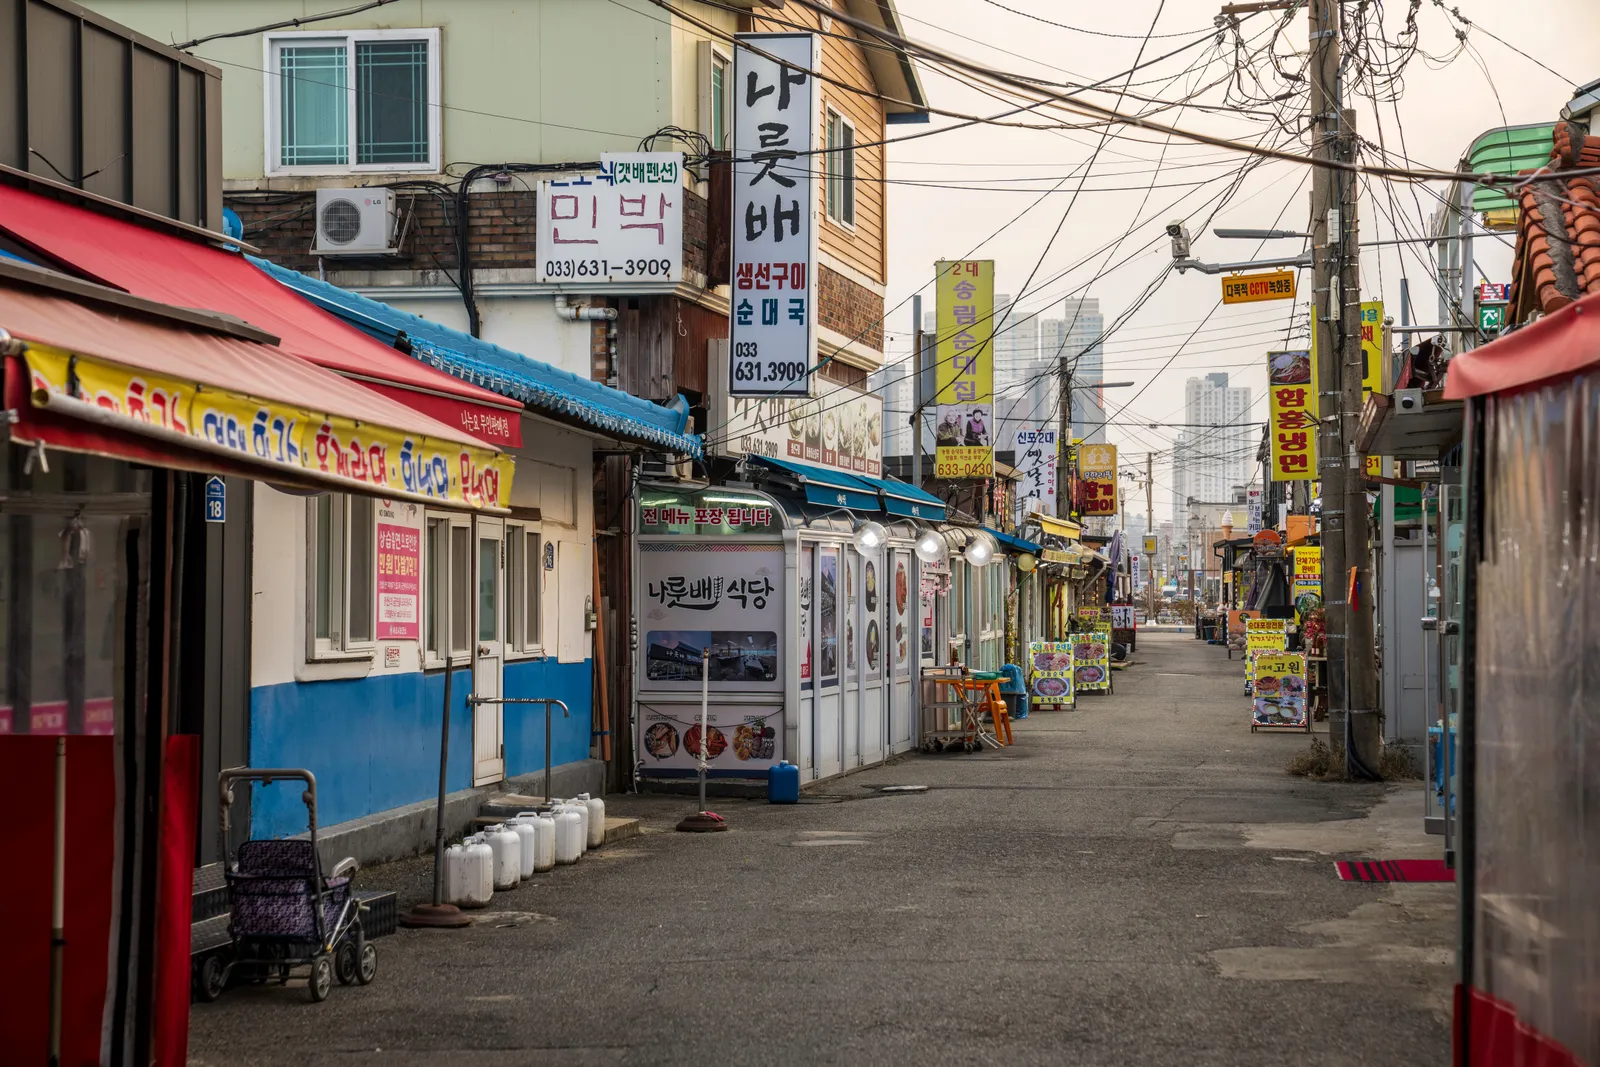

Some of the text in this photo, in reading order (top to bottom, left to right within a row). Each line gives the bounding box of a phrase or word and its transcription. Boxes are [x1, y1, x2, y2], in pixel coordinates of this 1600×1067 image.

[744, 60, 807, 244] 나룻배
[550, 192, 673, 246] 민박
[546, 259, 671, 279] 033)631-3909
[735, 262, 807, 291] 생선구이
[1225, 278, 1291, 298] 다목적 CCTV 녹화중
[735, 342, 758, 358] 033
[952, 280, 977, 401] 송림순대집
[735, 361, 806, 383] 631.3909
[460, 409, 480, 432] 나는요
[1275, 387, 1308, 474] 함흥냉면
[1017, 430, 1055, 445] 신포2대
[938, 463, 993, 476] 633-0430
[209, 500, 222, 518] 18
[643, 507, 772, 526] 전 메뉴 포장 됩니다
[726, 576, 775, 610] 식당
[1273, 661, 1300, 674] 고원
